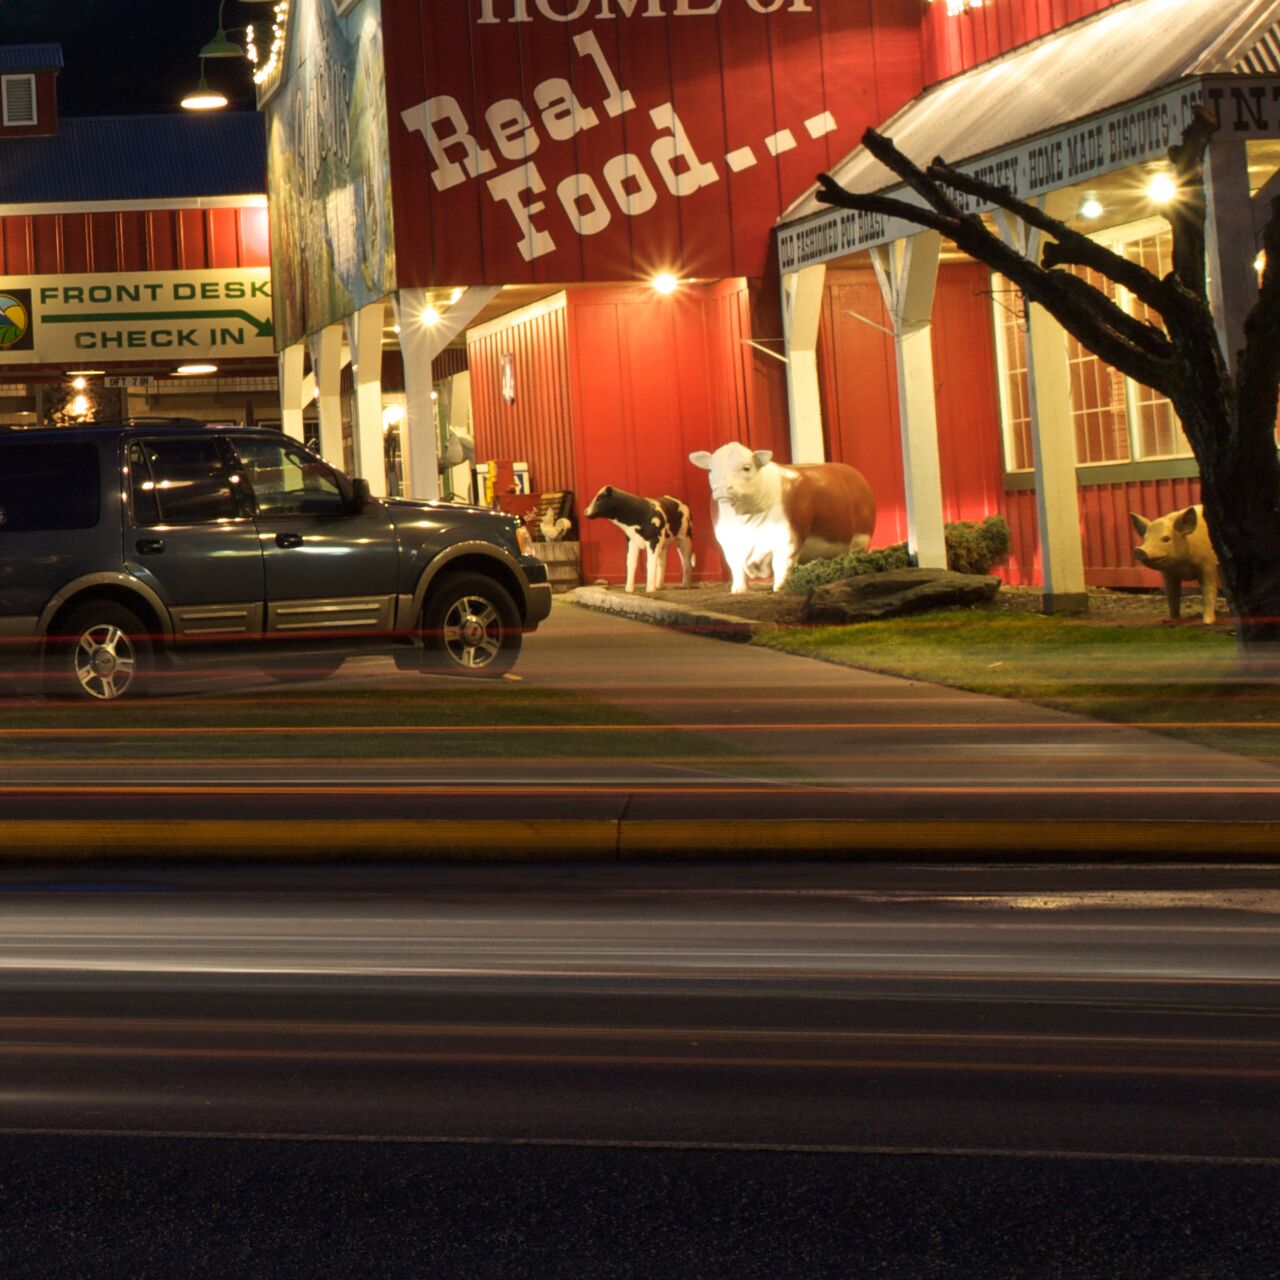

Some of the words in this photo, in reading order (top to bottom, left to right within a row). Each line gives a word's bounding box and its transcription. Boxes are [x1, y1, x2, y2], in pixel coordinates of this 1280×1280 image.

[401, 30, 637, 192] Real
[780, 234, 795, 269] OLD
[796, 218, 839, 265] FASHIONED
[841, 213, 856, 250] POT
[1029, 140, 1063, 190] HOME
[1067, 125, 1104, 177] MADE
[1109, 102, 1169, 163] BISCUITS
[41, 283, 163, 304] FRONT
[173, 280, 272, 301] DESK
[75, 328, 199, 350] CHECK
[210, 327, 245, 346] IN
